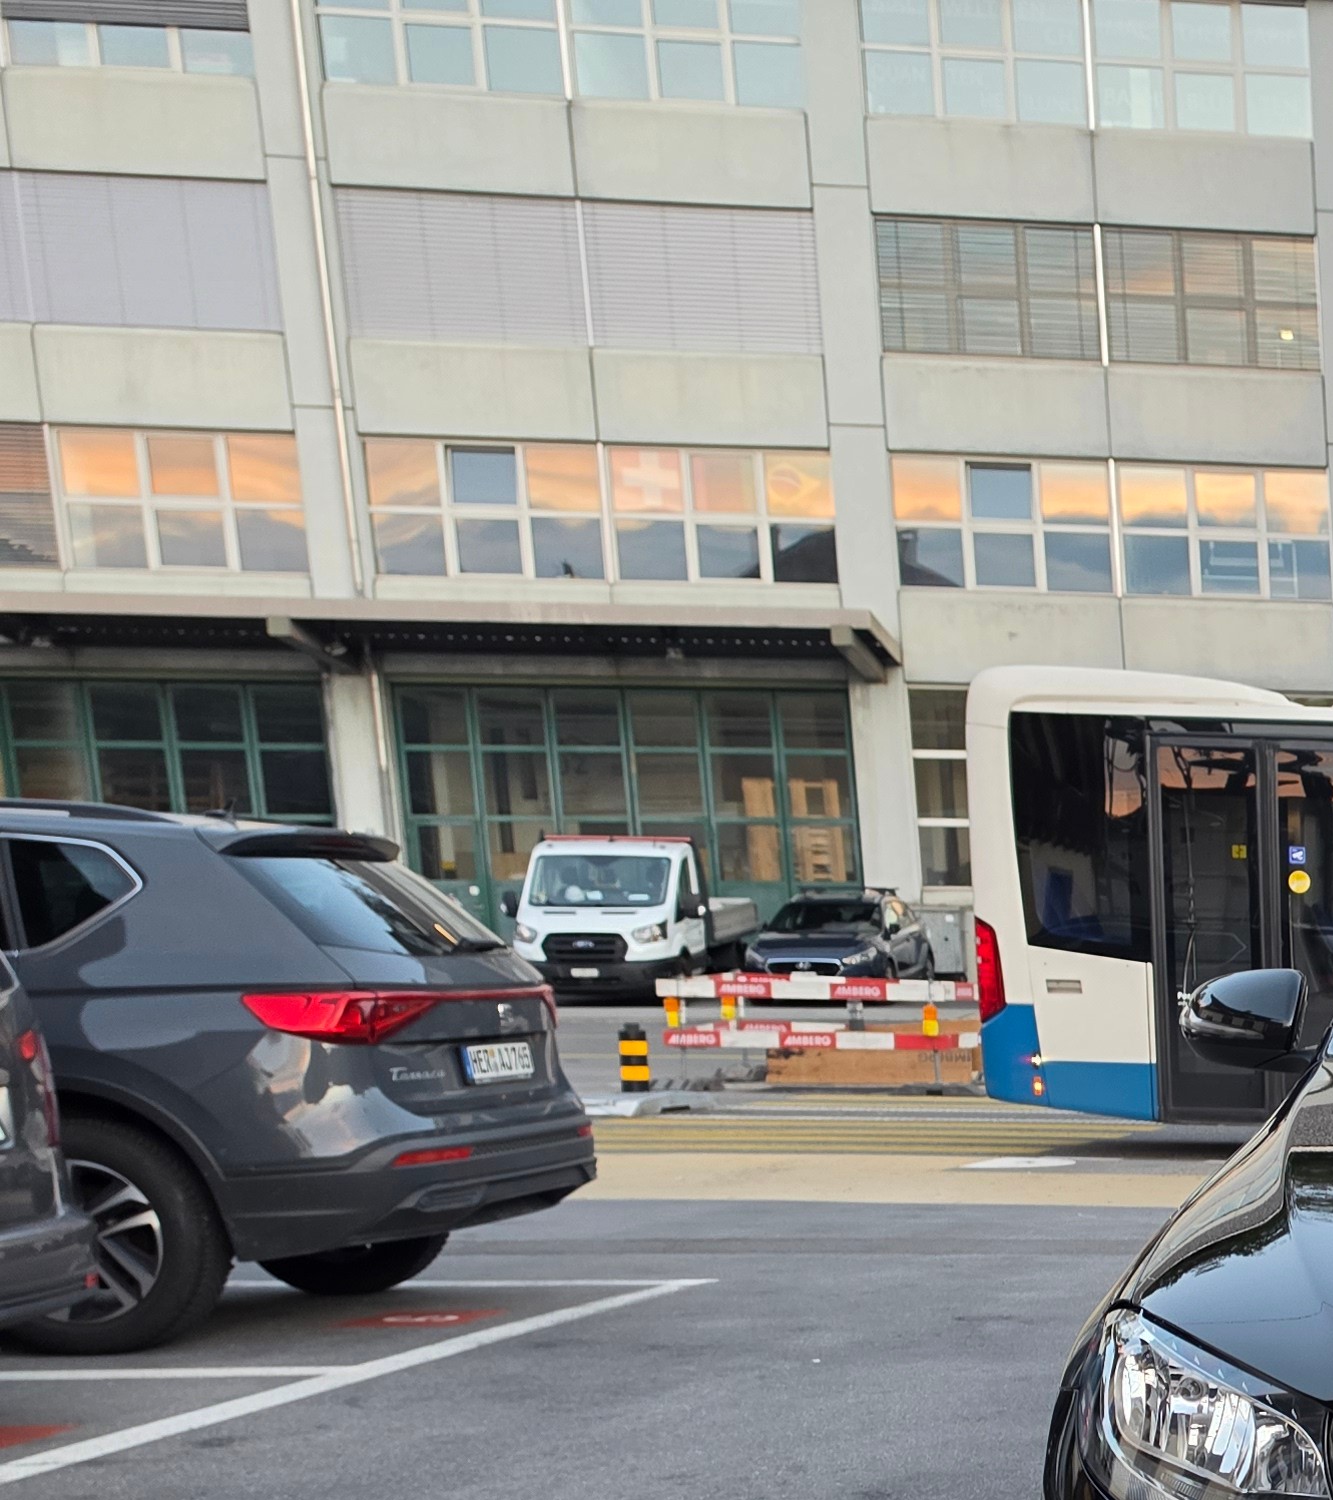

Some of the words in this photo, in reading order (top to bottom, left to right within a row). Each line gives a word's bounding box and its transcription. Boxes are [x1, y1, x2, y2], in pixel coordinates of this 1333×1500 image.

[719, 983, 766, 995] AMBERG
[833, 986, 881, 997] AMBERG
[668, 1032, 716, 1044] AMBERG
[784, 1035, 831, 1046] AMBERG
